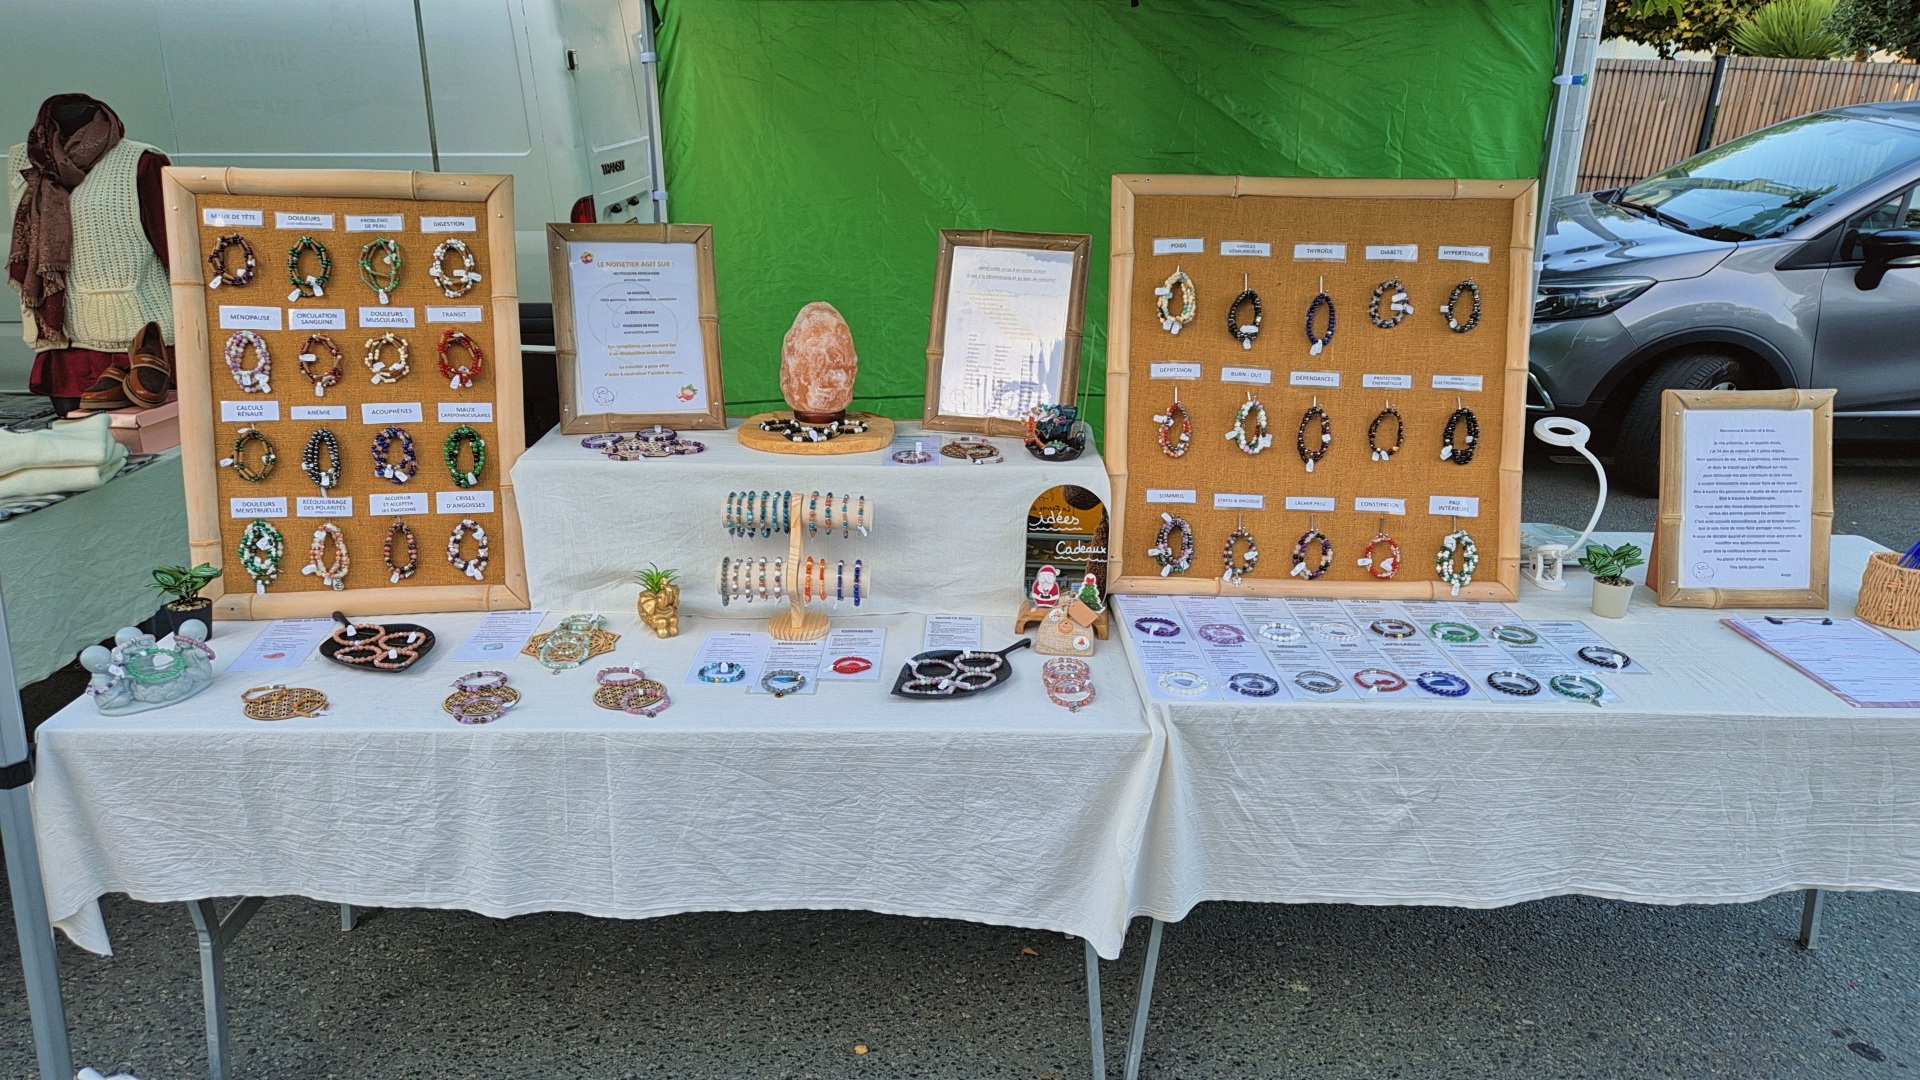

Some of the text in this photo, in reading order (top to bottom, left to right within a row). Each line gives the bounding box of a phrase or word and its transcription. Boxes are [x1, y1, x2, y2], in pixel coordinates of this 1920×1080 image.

[230, 313, 270, 321] MÉNOPAUSE
[1029, 510, 1080, 526] idées
[1056, 540, 1106, 555] Cadeaux
